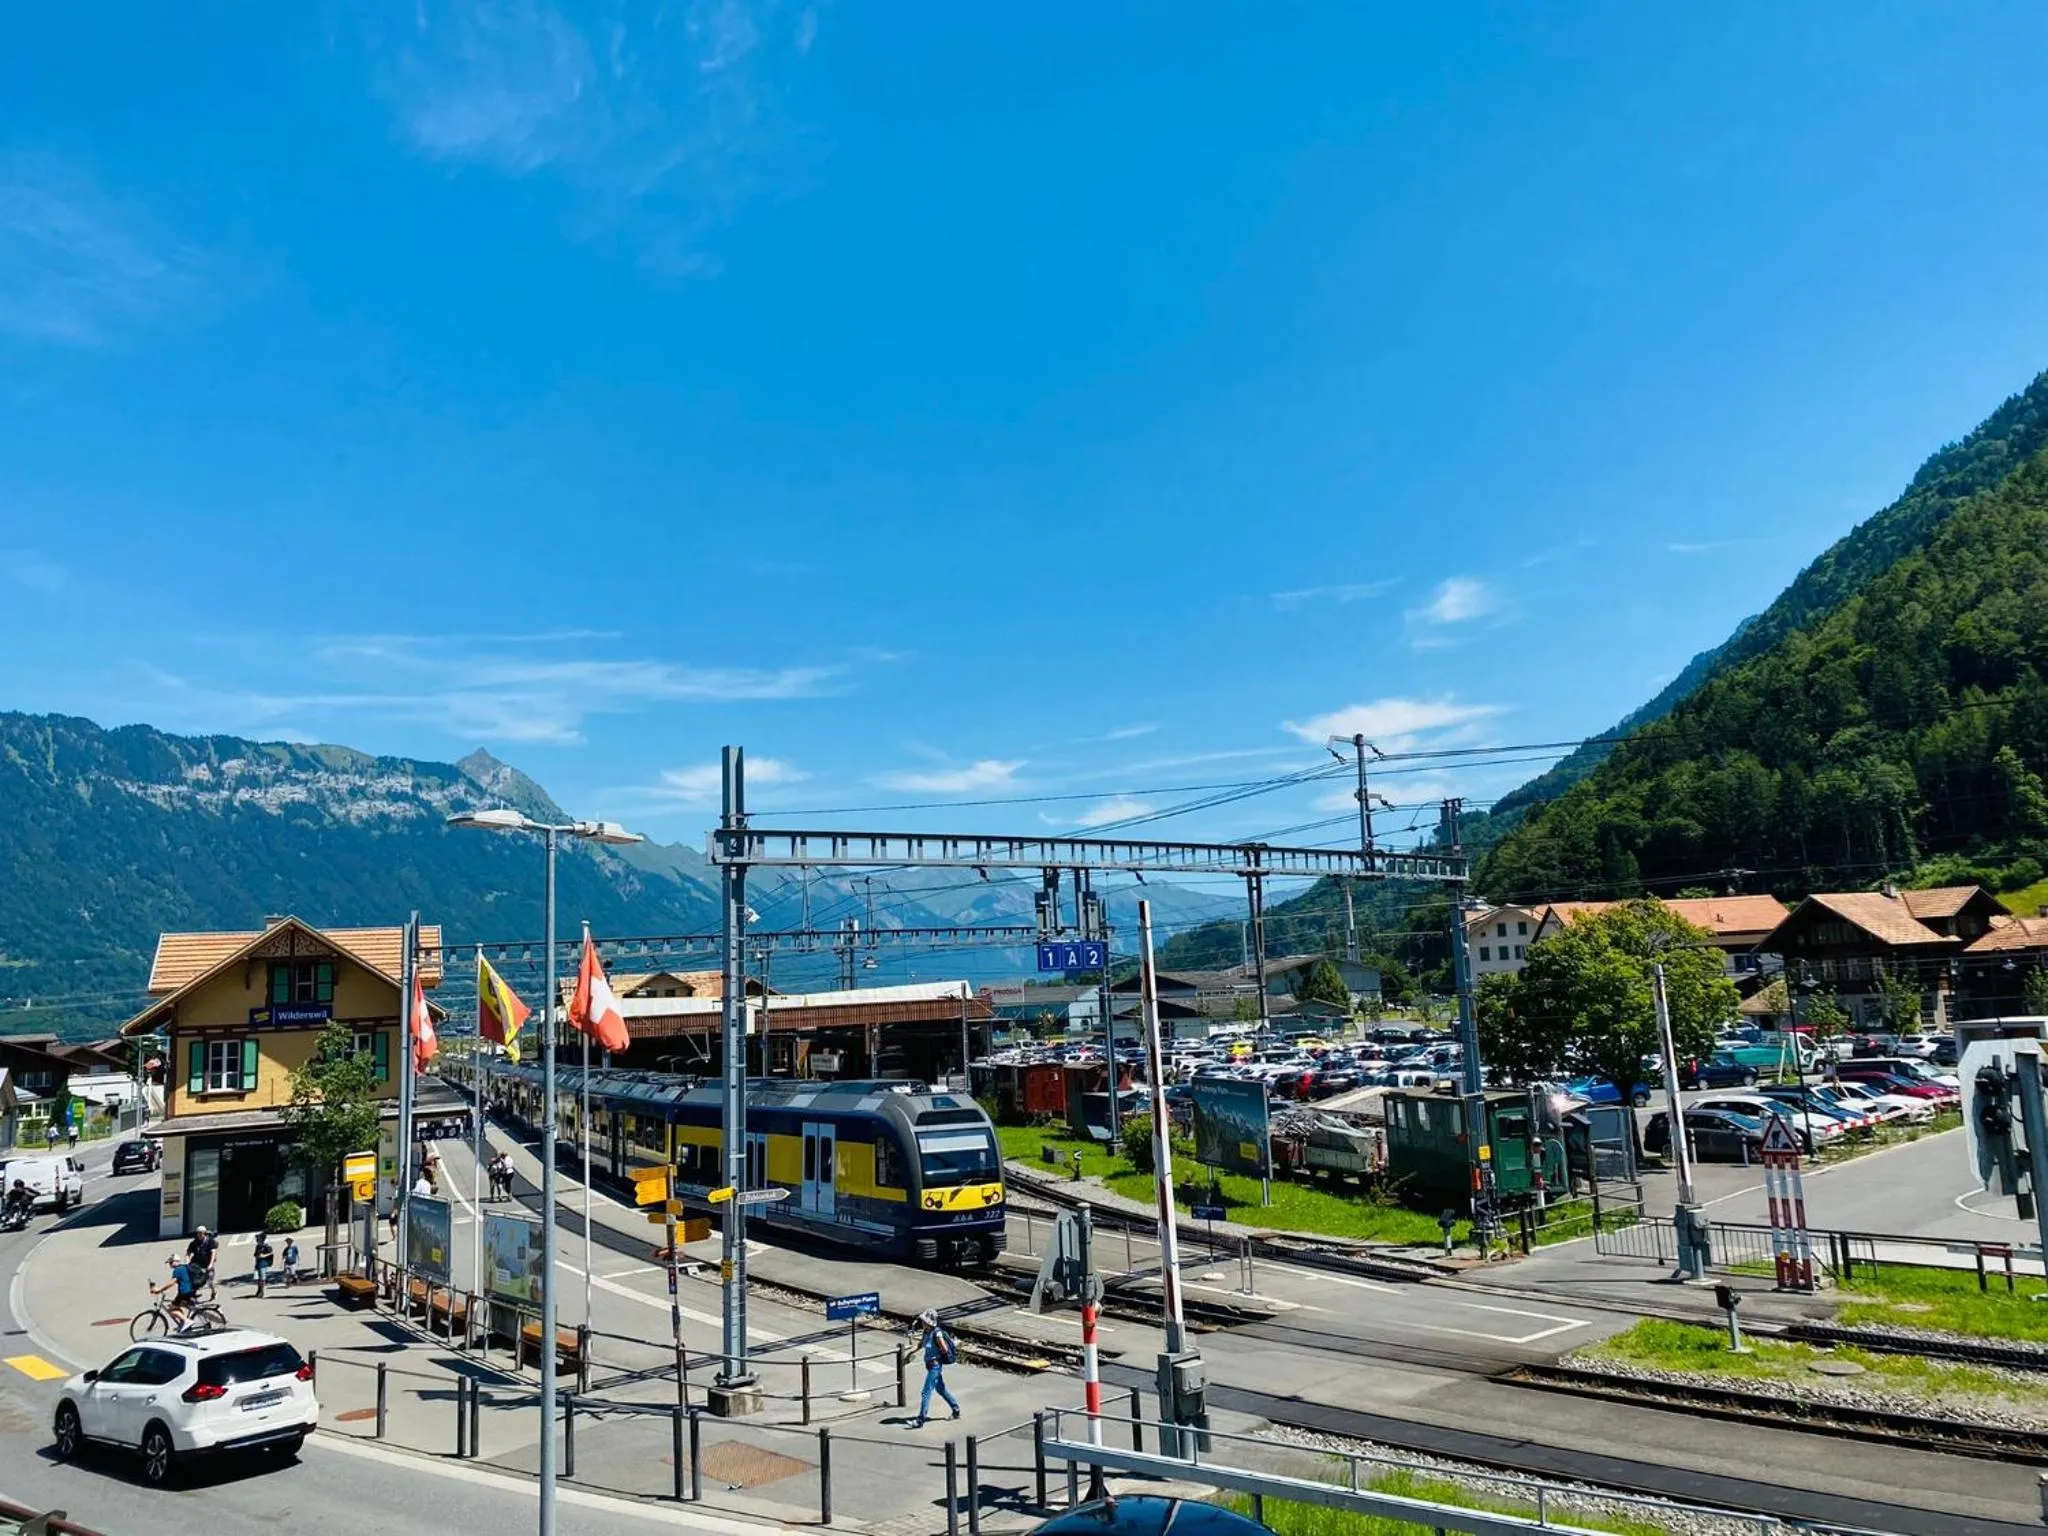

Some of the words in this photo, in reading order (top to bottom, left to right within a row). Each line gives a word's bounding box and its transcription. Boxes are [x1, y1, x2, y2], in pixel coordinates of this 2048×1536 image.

[1048, 951, 1053, 966] 1
[1068, 951, 1077, 966] A
[1089, 950, 1098, 965] 2
[278, 1010, 328, 1020] Wilderswil
